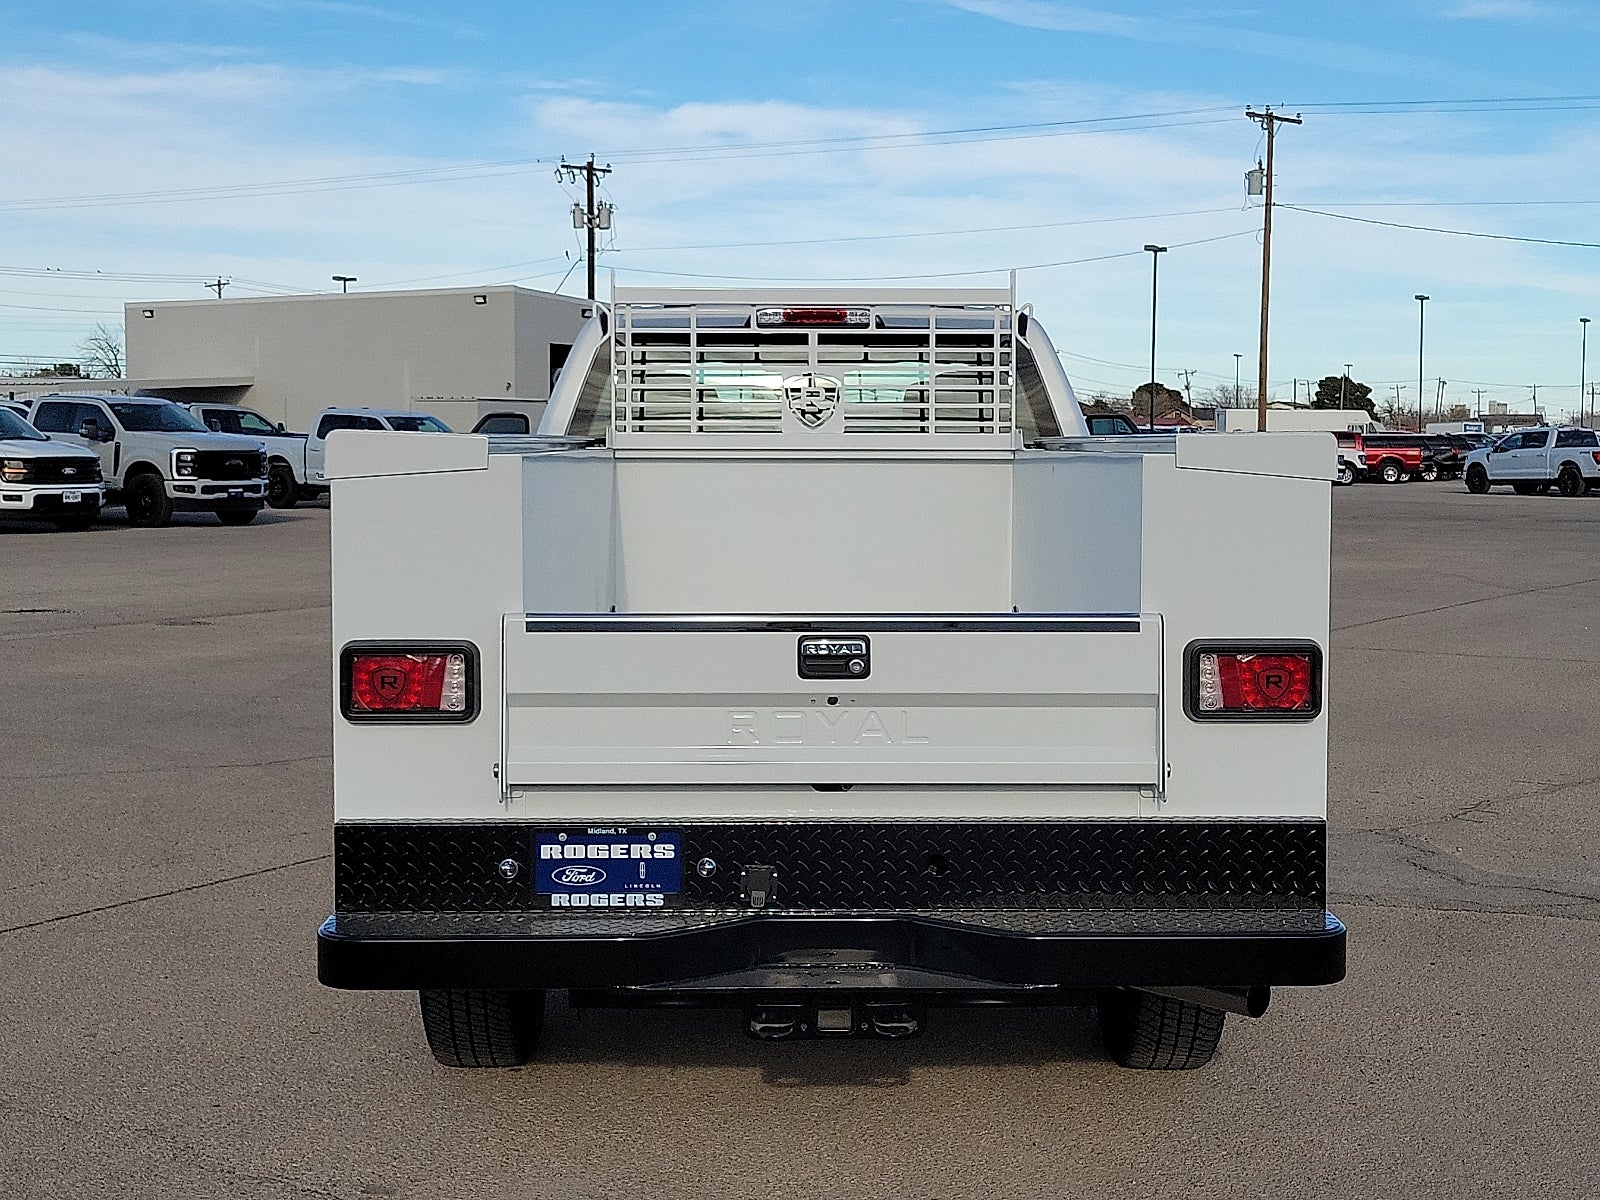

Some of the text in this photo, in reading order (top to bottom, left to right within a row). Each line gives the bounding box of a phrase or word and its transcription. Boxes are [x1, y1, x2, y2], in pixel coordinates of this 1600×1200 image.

[806, 644, 862, 655] ROYAL
[380, 675, 399, 690] R
[1265, 674, 1284, 690] R
[727, 710, 930, 744] ROYAL
[540, 844, 675, 859] ROGERS
[560, 867, 597, 883] Ford
[551, 893, 664, 907] ROGERS
